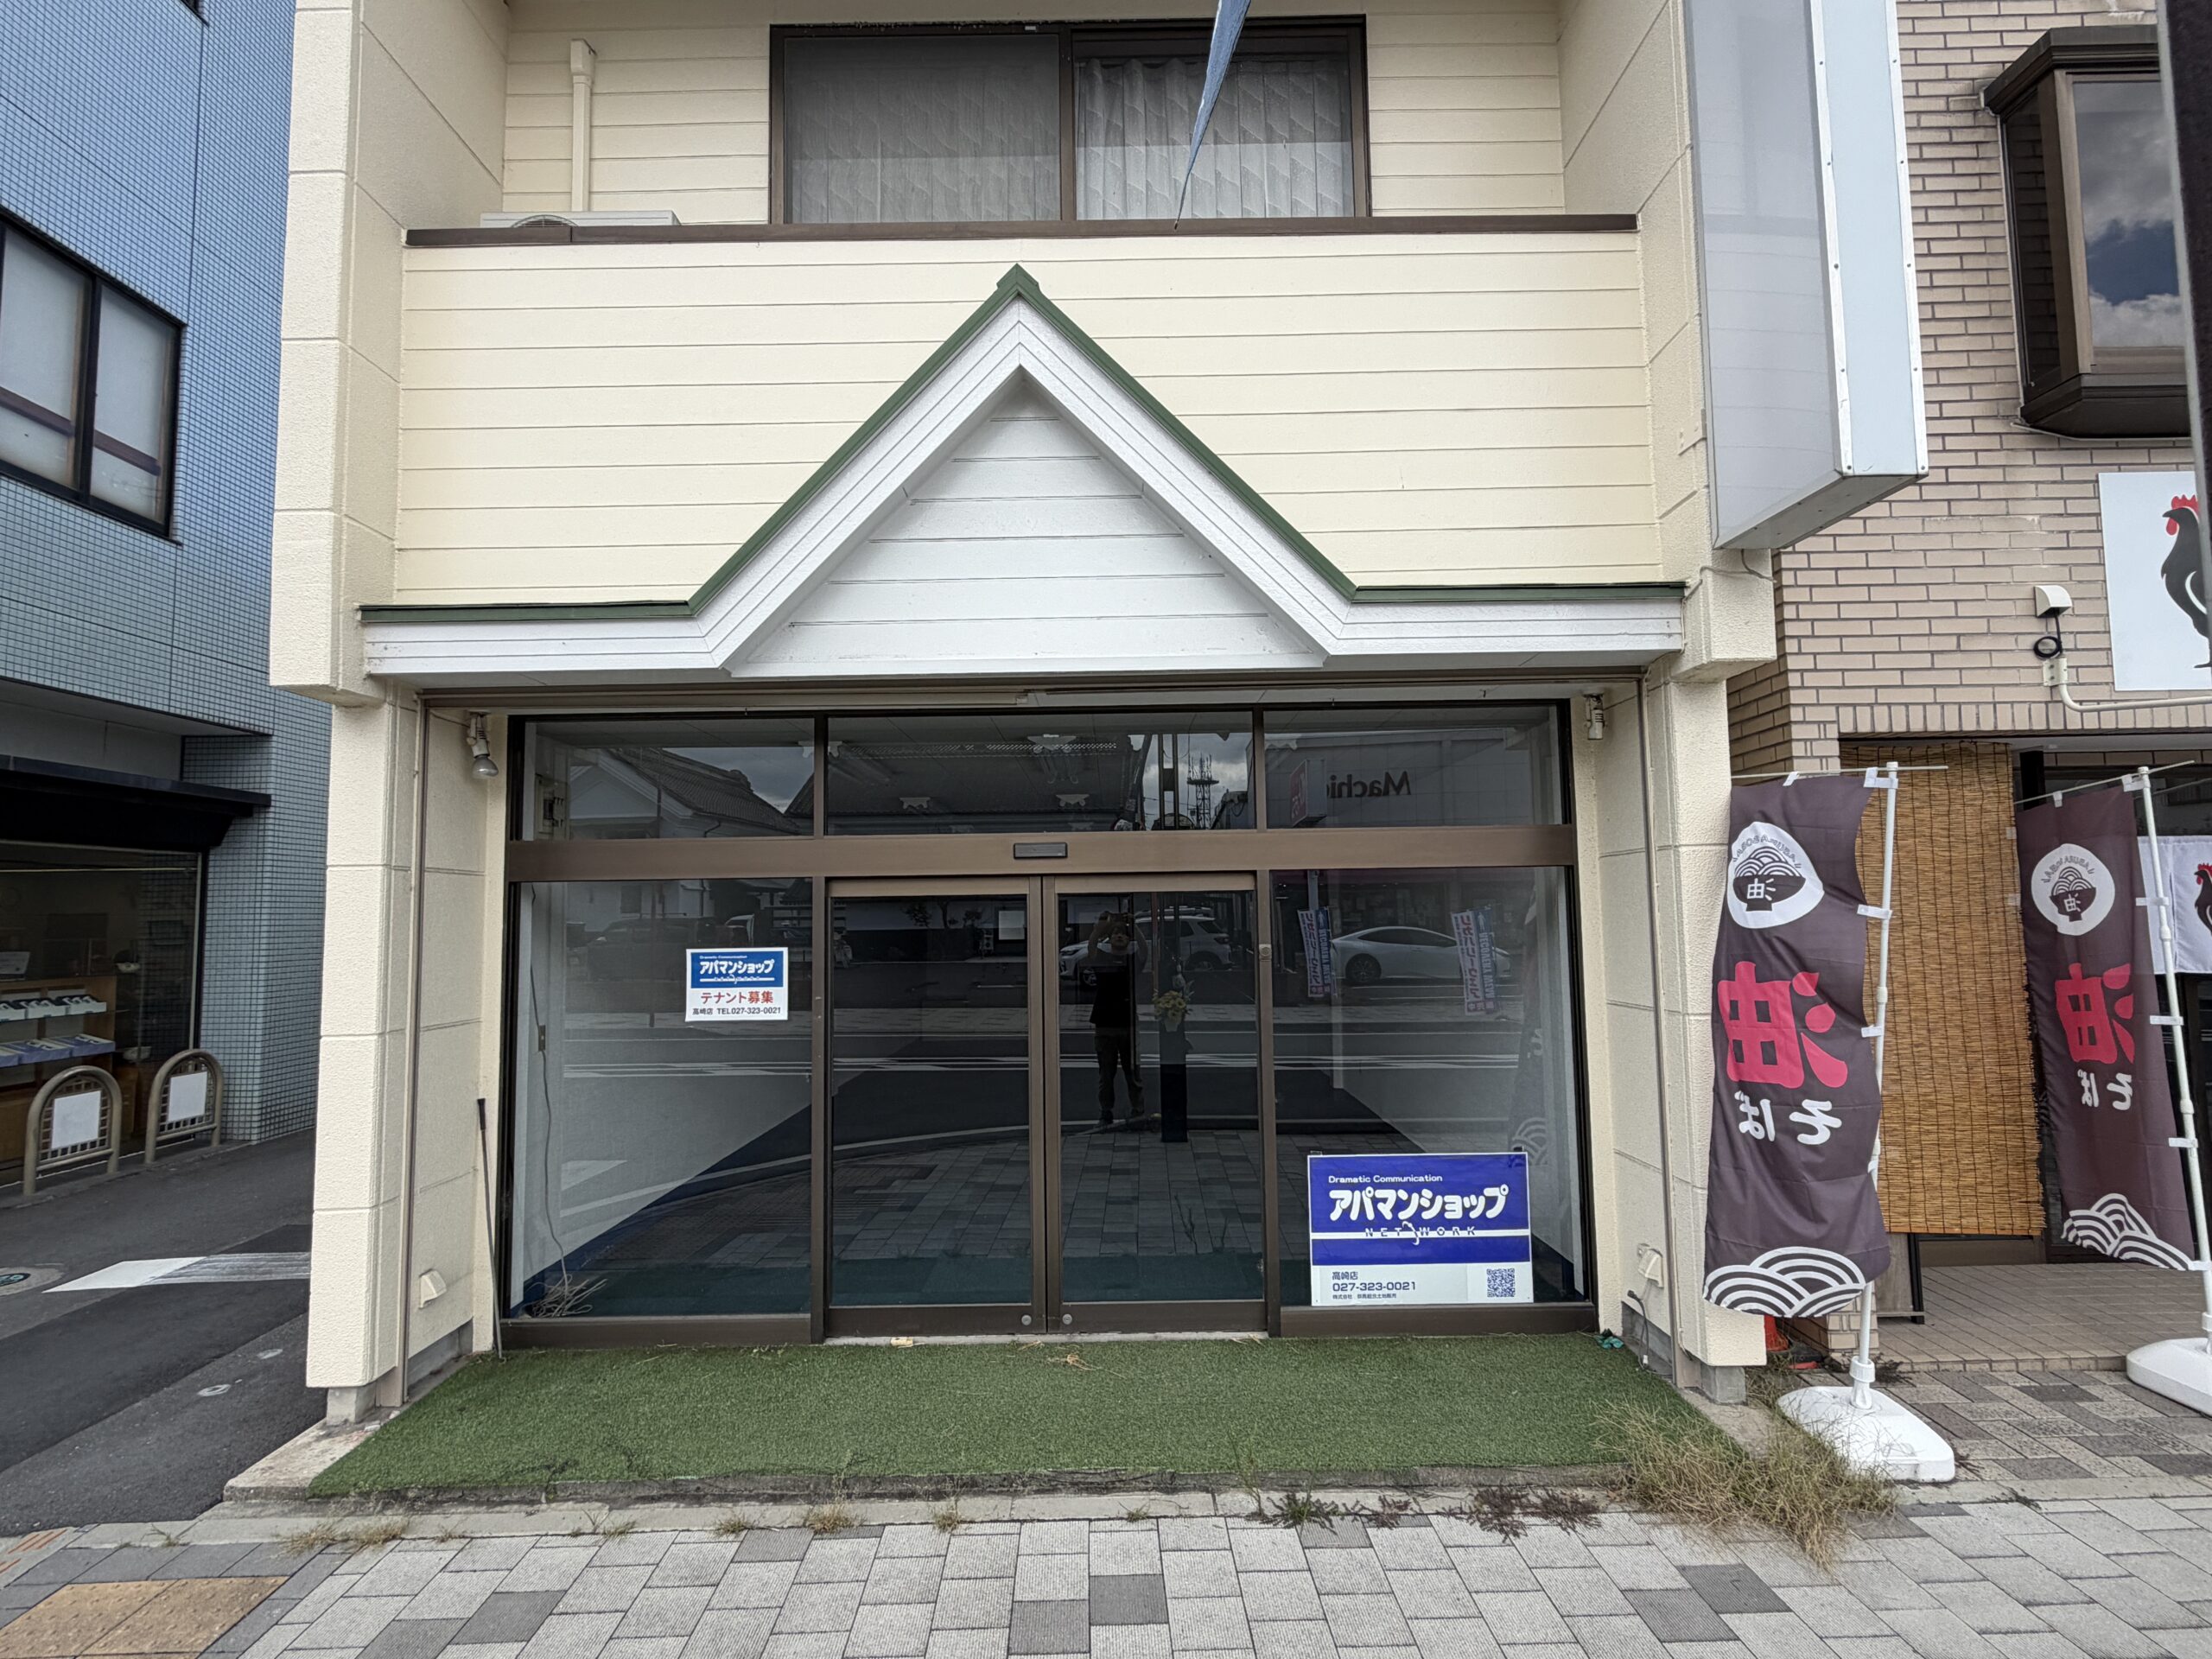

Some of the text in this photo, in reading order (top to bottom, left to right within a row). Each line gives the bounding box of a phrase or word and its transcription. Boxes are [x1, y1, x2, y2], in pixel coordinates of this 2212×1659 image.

[700, 958, 775, 975] アパマンショップ
[701, 990, 773, 1004] テナント募集
[1328, 1174, 1443, 1184] Dramatic Communication
[1329, 1184, 1510, 1221] アパマンショップ
[1332, 1281, 1416, 1292] 027-323-0021
